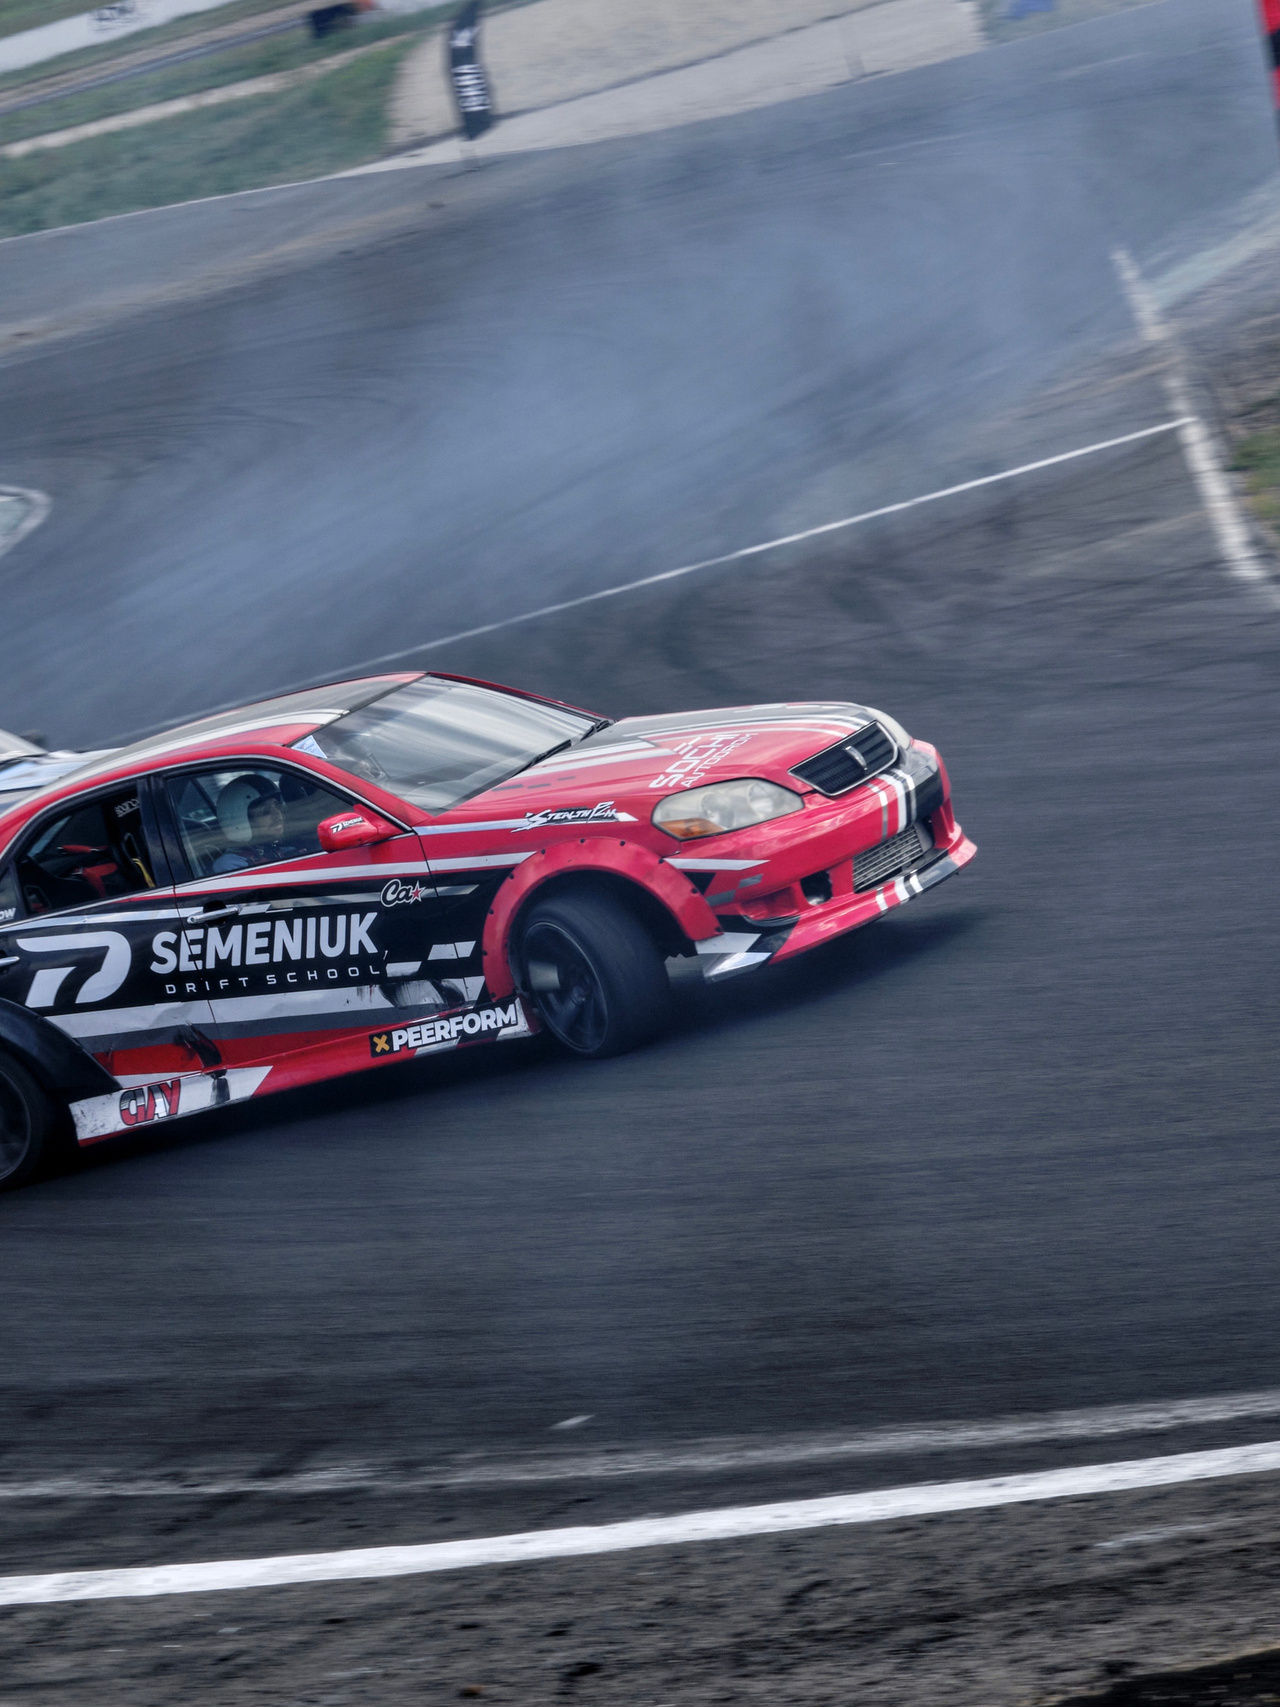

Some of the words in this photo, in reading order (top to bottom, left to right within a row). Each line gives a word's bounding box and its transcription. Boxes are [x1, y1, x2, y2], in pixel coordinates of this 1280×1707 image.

[648, 733, 741, 788] SOCHI
[149, 911, 379, 975] SEMENIUK
[165, 977, 250, 995] DRIFT
[266, 964, 381, 985] SCHOOL
[391, 1003, 518, 1052] PEERFORM
